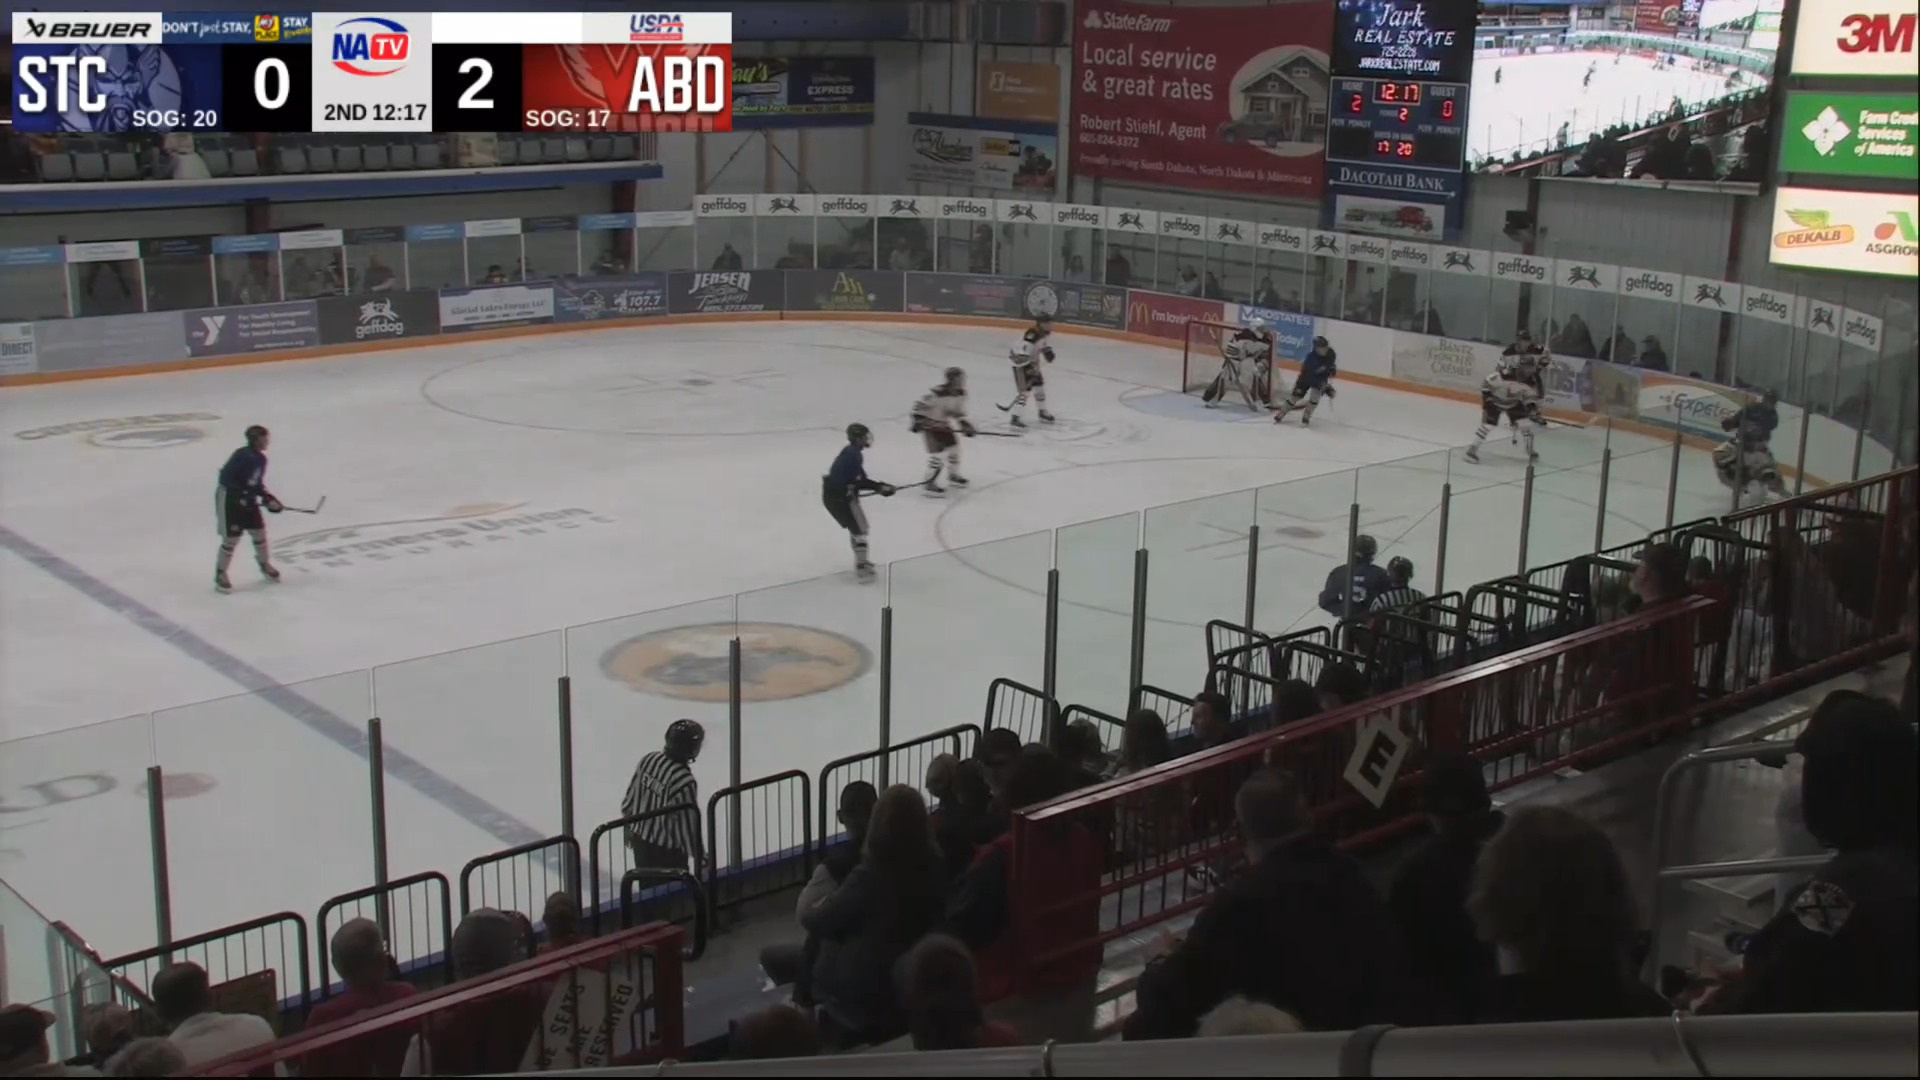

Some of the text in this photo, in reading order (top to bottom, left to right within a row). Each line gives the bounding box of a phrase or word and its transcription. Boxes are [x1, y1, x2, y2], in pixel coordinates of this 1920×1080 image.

[1375, 3, 1427, 28] Jark
[1354, 28, 1456, 48] REAL ESTATE
[1836, 13, 1918, 54] 3M
[1083, 40, 1217, 71] Local service
[732, 61, 768, 84] ay's
[807, 85, 855, 96] EXPRESS
[1081, 69, 1214, 101] & great rates
[1380, 83, 1420, 101] 12:17
[1430, 86, 1457, 97] GUEST
[1351, 94, 1363, 112] 2
[1399, 107, 1409, 121] 2
[1442, 100, 1454, 117] 0
[1859, 109, 1889, 125] Farm
[1080, 113, 1122, 133] Robert
[1168, 121, 1207, 142] Agent
[1857, 125, 1907, 141] Services
[1377, 140, 1413, 156] 17 20
[1854, 141, 1915, 157] of America
[1140, 158, 1165, 171] South
[1199, 164, 1225, 178] North
[1266, 170, 1313, 185] Minnesota
[1340, 167, 1445, 191] DACOTAH BANK
[701, 196, 747, 214] geffdog
[821, 196, 868, 214] geffdog
[942, 199, 987, 218] geffdog
[1057, 207, 1099, 226] geffdog
[1163, 217, 1200, 236] geffdog
[1261, 228, 1301, 249] geffdog
[1787, 229, 1841, 246] DEKALB
[1350, 241, 1385, 259] geffdog
[1390, 245, 1428, 264] geffdog
[1497, 258, 1545, 280] geffdog
[1625, 273, 1673, 297] geffdog
[629, 295, 662, 307] 107.7
[1746, 292, 1788, 319] geffdog
[355, 317, 404, 339] geffdog
[1845, 316, 1877, 345] geffdog
[1, 341, 33, 356] DIRECT
[1358, 729, 1398, 789] E
